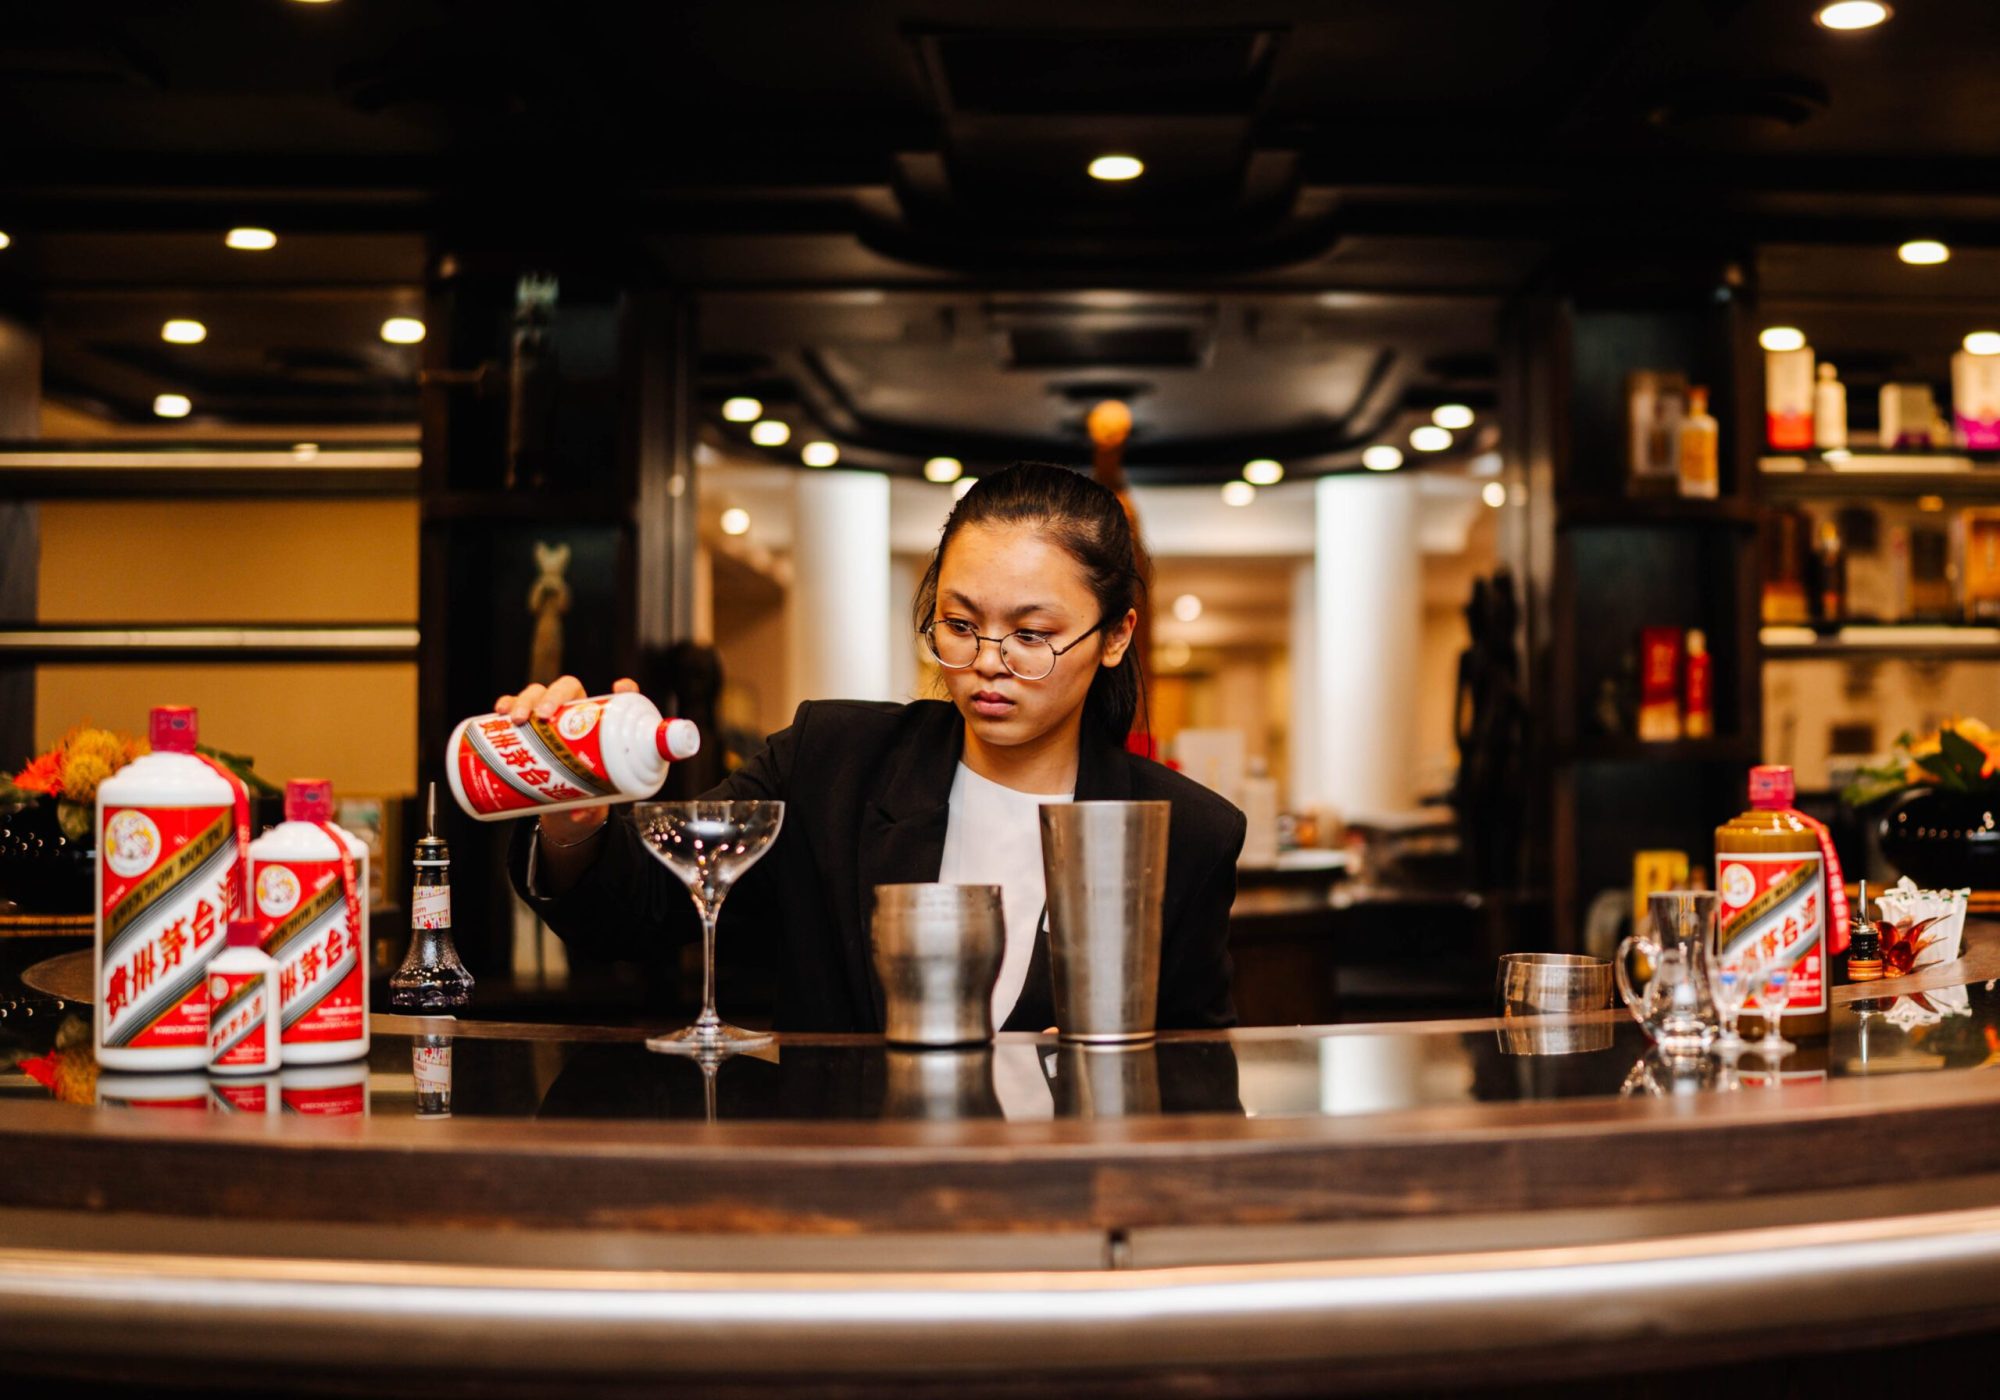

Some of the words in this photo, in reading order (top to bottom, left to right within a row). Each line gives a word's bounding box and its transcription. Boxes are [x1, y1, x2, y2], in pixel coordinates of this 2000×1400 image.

[279, 908, 359, 1010] 州茅台
[1743, 890, 1816, 972] 茅台酒
